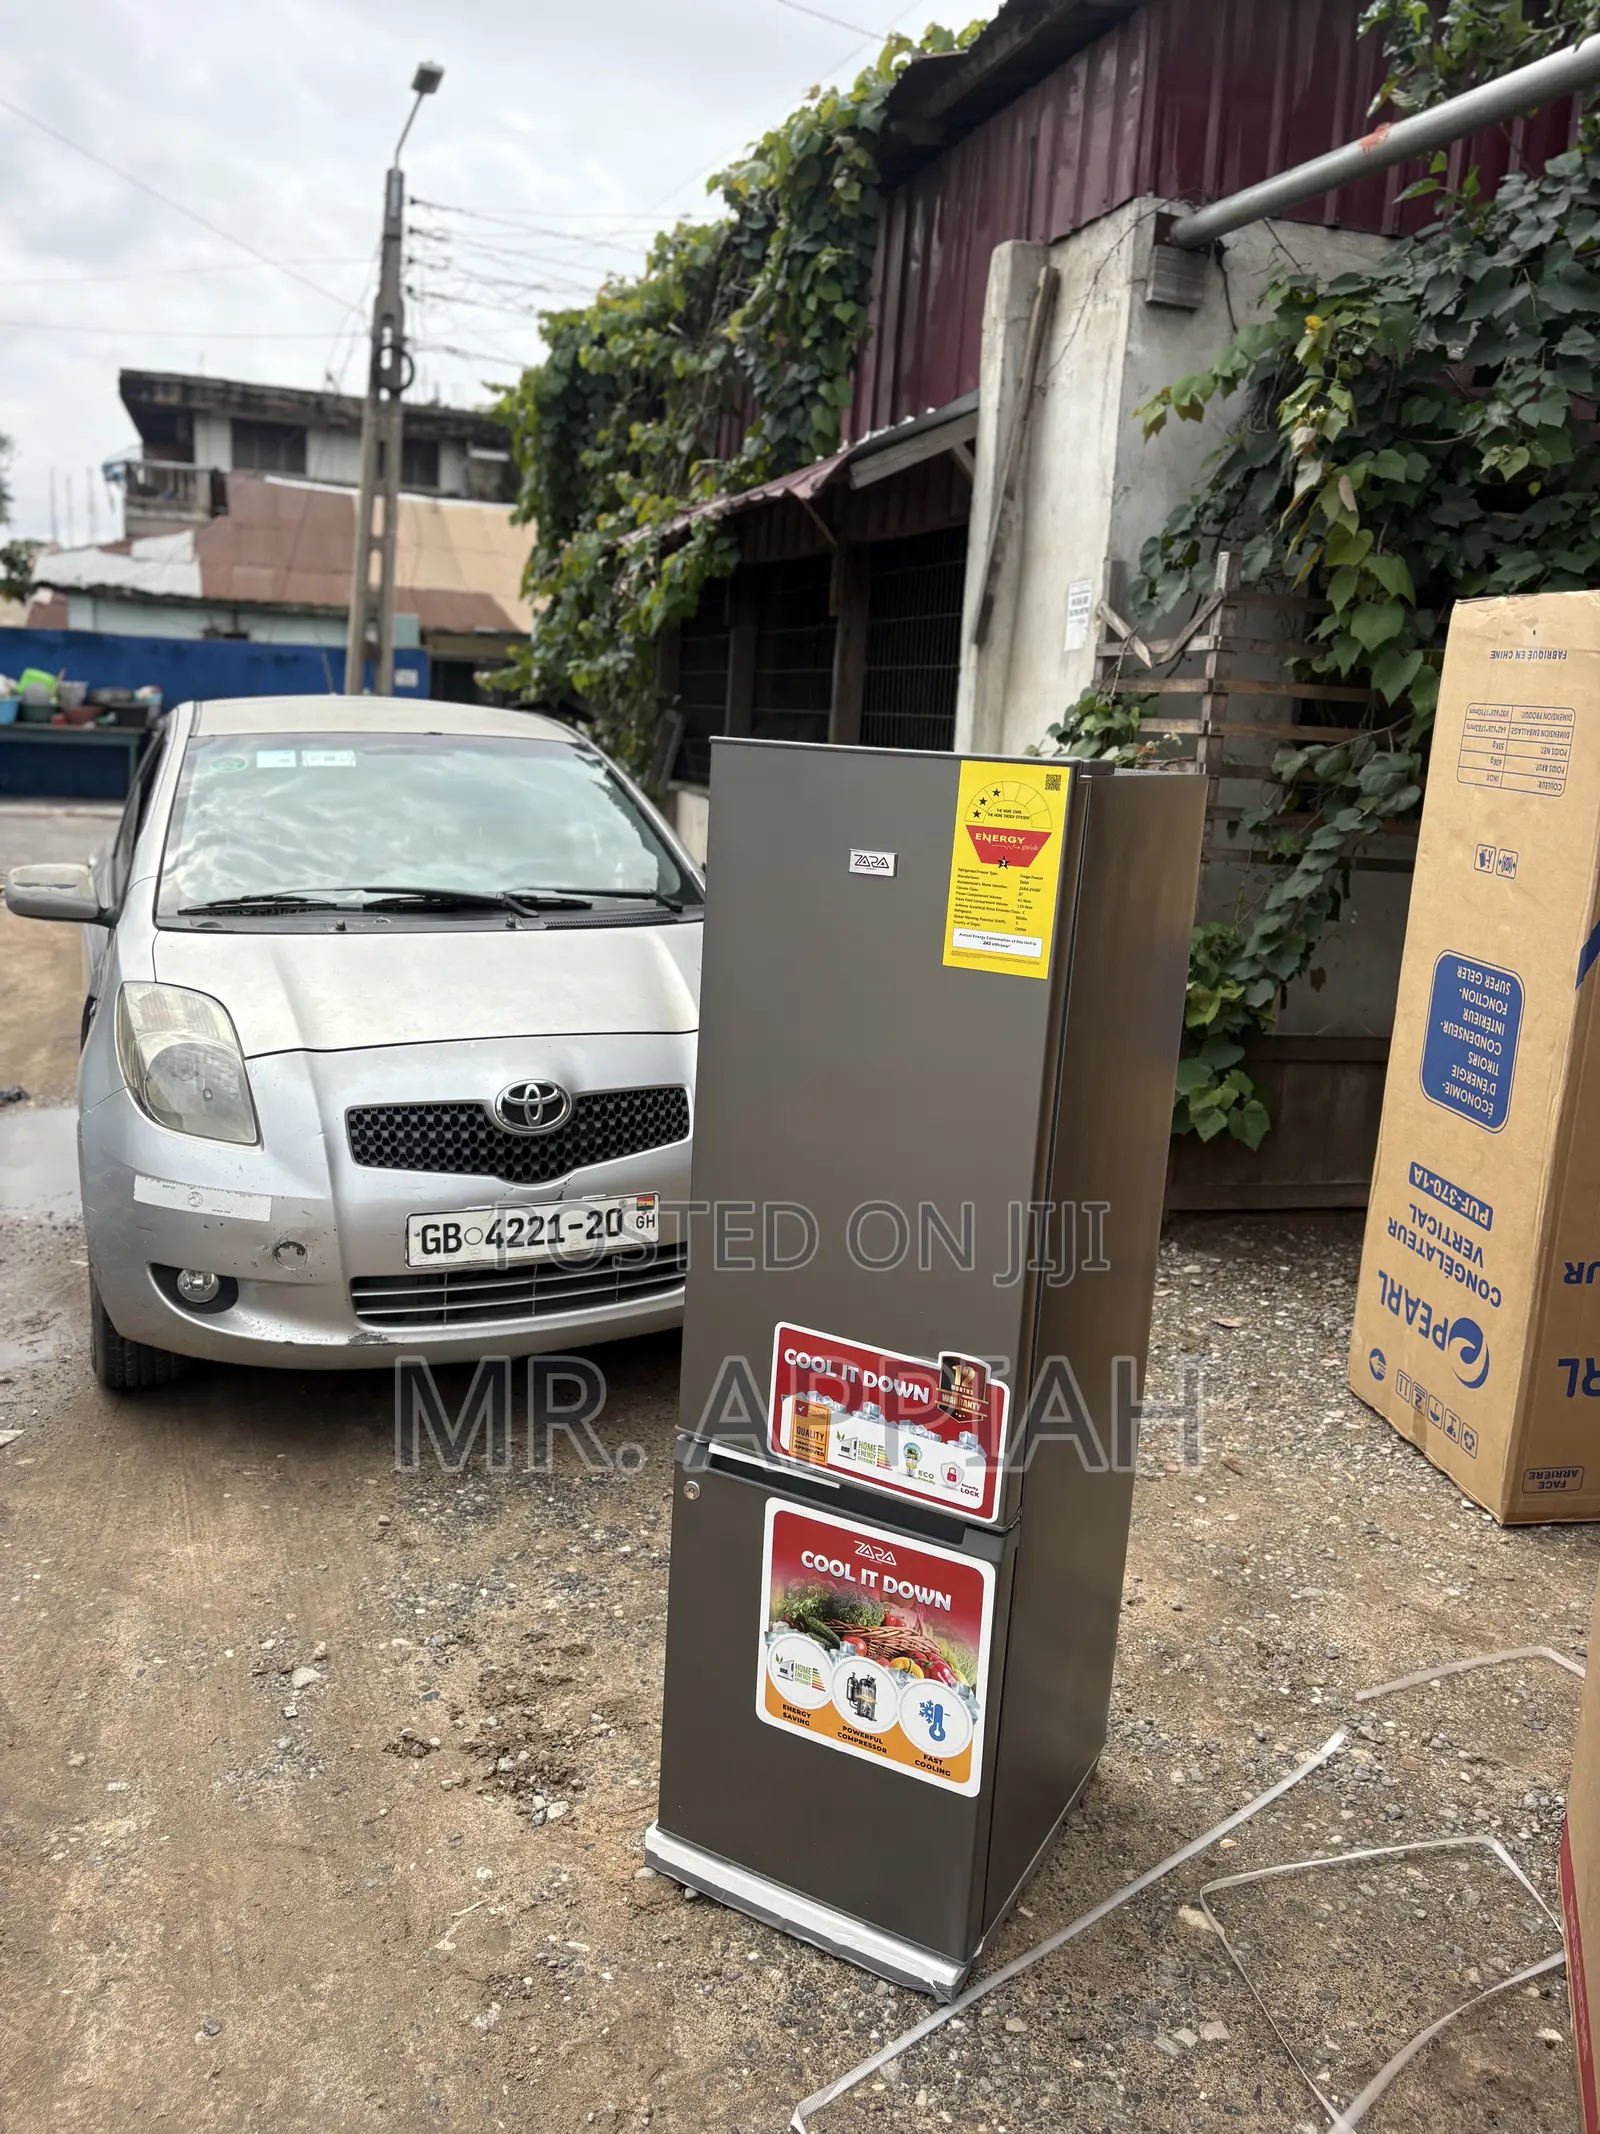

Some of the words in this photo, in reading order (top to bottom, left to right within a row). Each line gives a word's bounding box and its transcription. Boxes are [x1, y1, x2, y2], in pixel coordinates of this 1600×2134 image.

[1490, 650, 1514, 659] CHINE
[1516, 650, 1526, 659] EN
[1527, 650, 1567, 661] FABRIQUÉ
[1545, 713, 1573, 722] DIMENSION
[1542, 730, 1570, 740] DIMENSION
[1552, 748, 1568, 756] POIDS
[1549, 765, 1564, 774] POIDS
[975, 832, 1026, 844] ENERGY
[1021, 844, 1040, 852] guide
[854, 854, 890, 868] ZARA
[1456, 965, 1482, 985] GELER
[1485, 975, 1511, 996] SUPER
[1458, 987, 1508, 1016] FONCTION-
[1463, 1008, 1506, 1036] INTÉRIEUR
[1440, 1020, 1502, 1056] CONDENSEUR-
[1468, 1051, 1499, 1076] TIROIRS
[1451, 1064, 1496, 1096] D'ÉNERGIE
[1442, 1082, 1494, 1118] ÉCONOMIE-
[1413, 1166, 1493, 1227] PUF-370-1A
[636, 1214, 655, 1230] GH
[421, 1222, 462, 1254] GB
[485, 1208, 623, 1249] 4221-20
[1408, 1202, 1484, 1268] VERTICAL
[1387, 1216, 1502, 1308] CONGÉLATEUR
[1378, 1269, 1449, 1351] PEARL
[784, 1348, 837, 1380] COOL
[841, 1364, 860, 1384] IT
[863, 1370, 930, 1404] DOWN
[952, 1364, 976, 1388] 12
[942, 1394, 982, 1412] WARRANTY
[796, 1426, 824, 1442] QUALITY
[794, 1444, 824, 1456] APPROVED
[858, 1440, 877, 1454] HOME
[858, 1448, 877, 1460] ENERGY
[918, 1470, 934, 1480] ECO
[1528, 1470, 1579, 1480] ARRIÈRE
[1538, 1480, 1566, 1489] FACE
[960, 1488, 980, 1498] LOCK
[854, 1540, 897, 1566] ZARA
[801, 1550, 857, 1582] COOL
[860, 1568, 878, 1588] IT
[882, 1575, 952, 1612] DOWN
[794, 1662, 812, 1676] HOME
[794, 1670, 812, 1682] ENERGY
[782, 1704, 812, 1719] ENERGY
[782, 1712, 810, 1727] SAVING
[837, 1732, 887, 1754] COMPRESSOR
[842, 1725, 883, 1745] POWERFUL
[914, 1759, 951, 1776] COOLING
[923, 1754, 943, 1766] FAST
